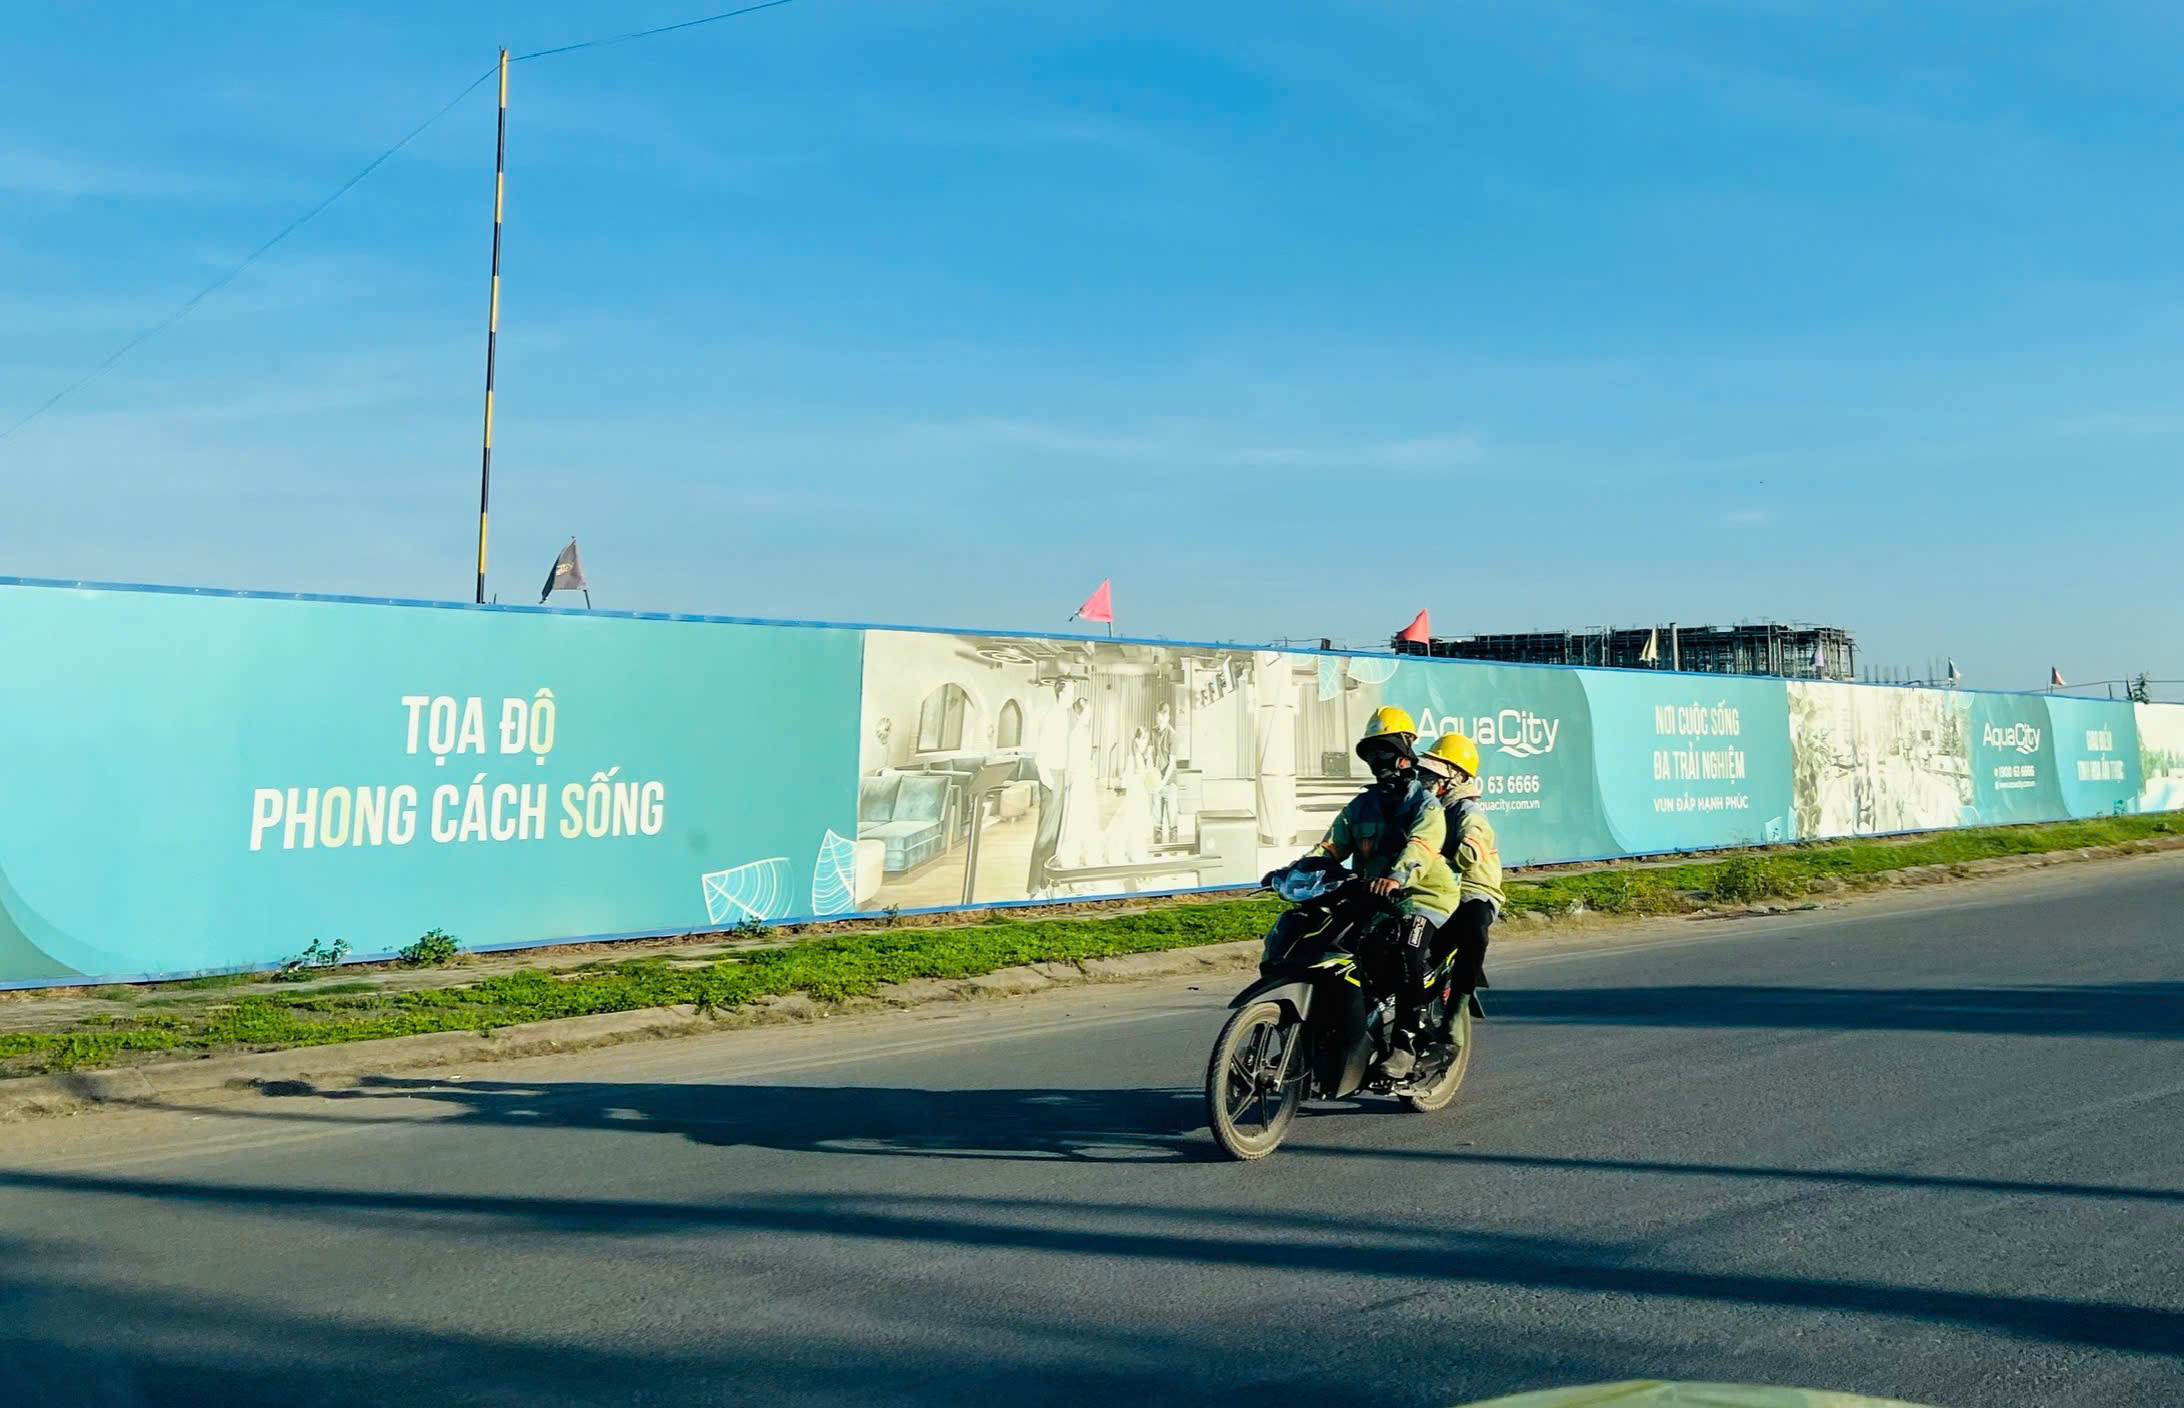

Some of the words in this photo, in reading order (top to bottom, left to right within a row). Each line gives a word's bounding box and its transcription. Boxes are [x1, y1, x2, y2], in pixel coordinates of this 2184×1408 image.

[401, 696, 486, 766] TỌA
[499, 687, 556, 766] ĐỘ
[1655, 704, 1676, 735] NƠI
[1678, 701, 1708, 741] CUỘC
[1711, 699, 1740, 736] SỐNG
[1983, 722, 2041, 755] AquaCity
[1653, 751, 1671, 780] ĐA
[1673, 741, 1700, 780] TRẢI
[1702, 744, 1745, 784] NGHIỆM
[1487, 775, 1504, 795] 63
[1507, 774, 1540, 794] 6666
[1653, 797, 1674, 812] VUN
[1725, 792, 1749, 809] PHÚC
[249, 785, 418, 851] PHONG
[430, 772, 547, 843] CÁCH
[559, 766, 664, 839] SỐNG
